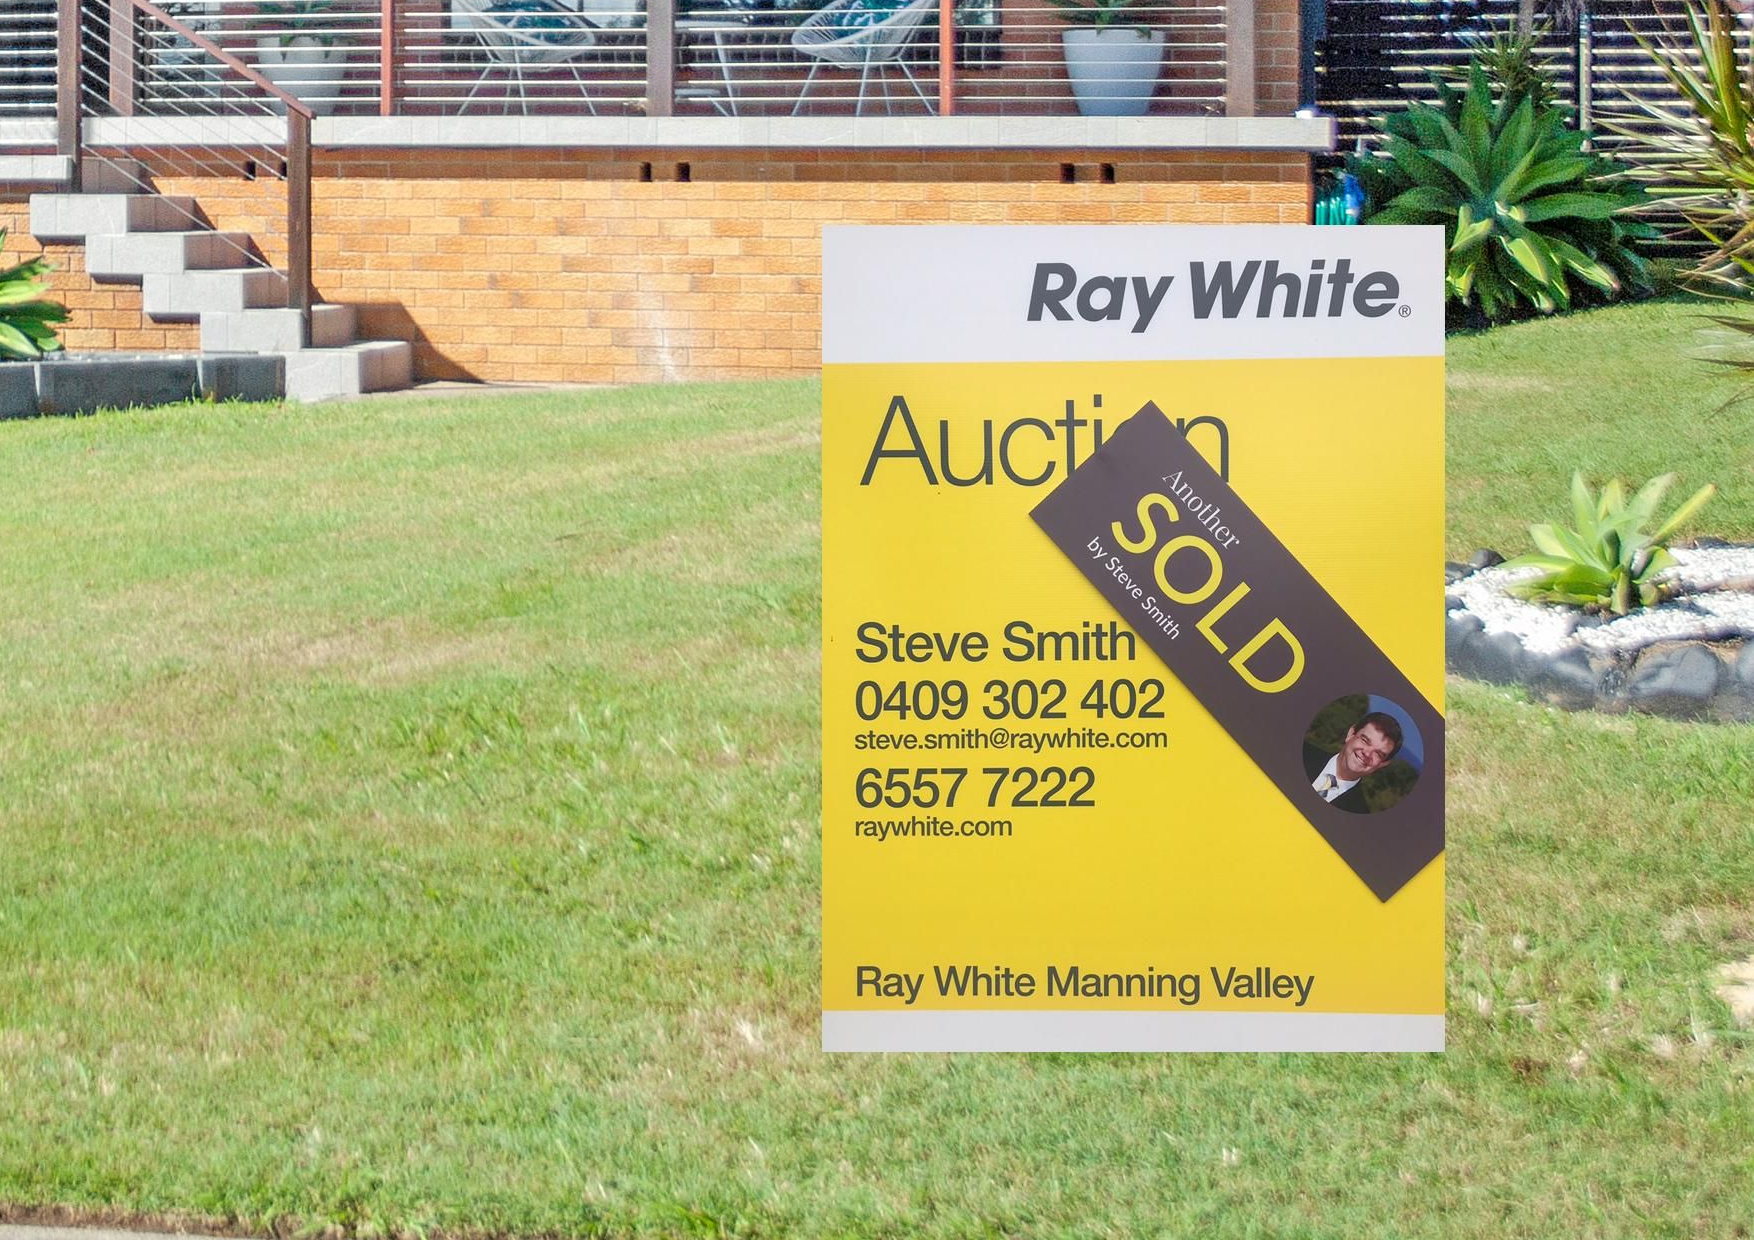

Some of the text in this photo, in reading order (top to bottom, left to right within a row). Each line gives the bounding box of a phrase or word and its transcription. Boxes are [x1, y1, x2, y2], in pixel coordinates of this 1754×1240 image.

[1026, 262, 1175, 334] Ray
[859, 394, 1230, 488] Auctin
[1161, 470, 1240, 550] Another
[1086, 535, 1180, 640] by Steve Smith
[1111, 492, 1306, 694] SOLD
[855, 620, 1136, 664] Steve Smith
[855, 678, 1165, 721] 0409 302 402
[854, 727, 1168, 754] steve.smith@raywhite.com
[855, 766, 1096, 809] 6557 7222
[855, 815, 1013, 842] raywhite.com
[856, 965, 1315, 1007] Ray White Manning Valley
